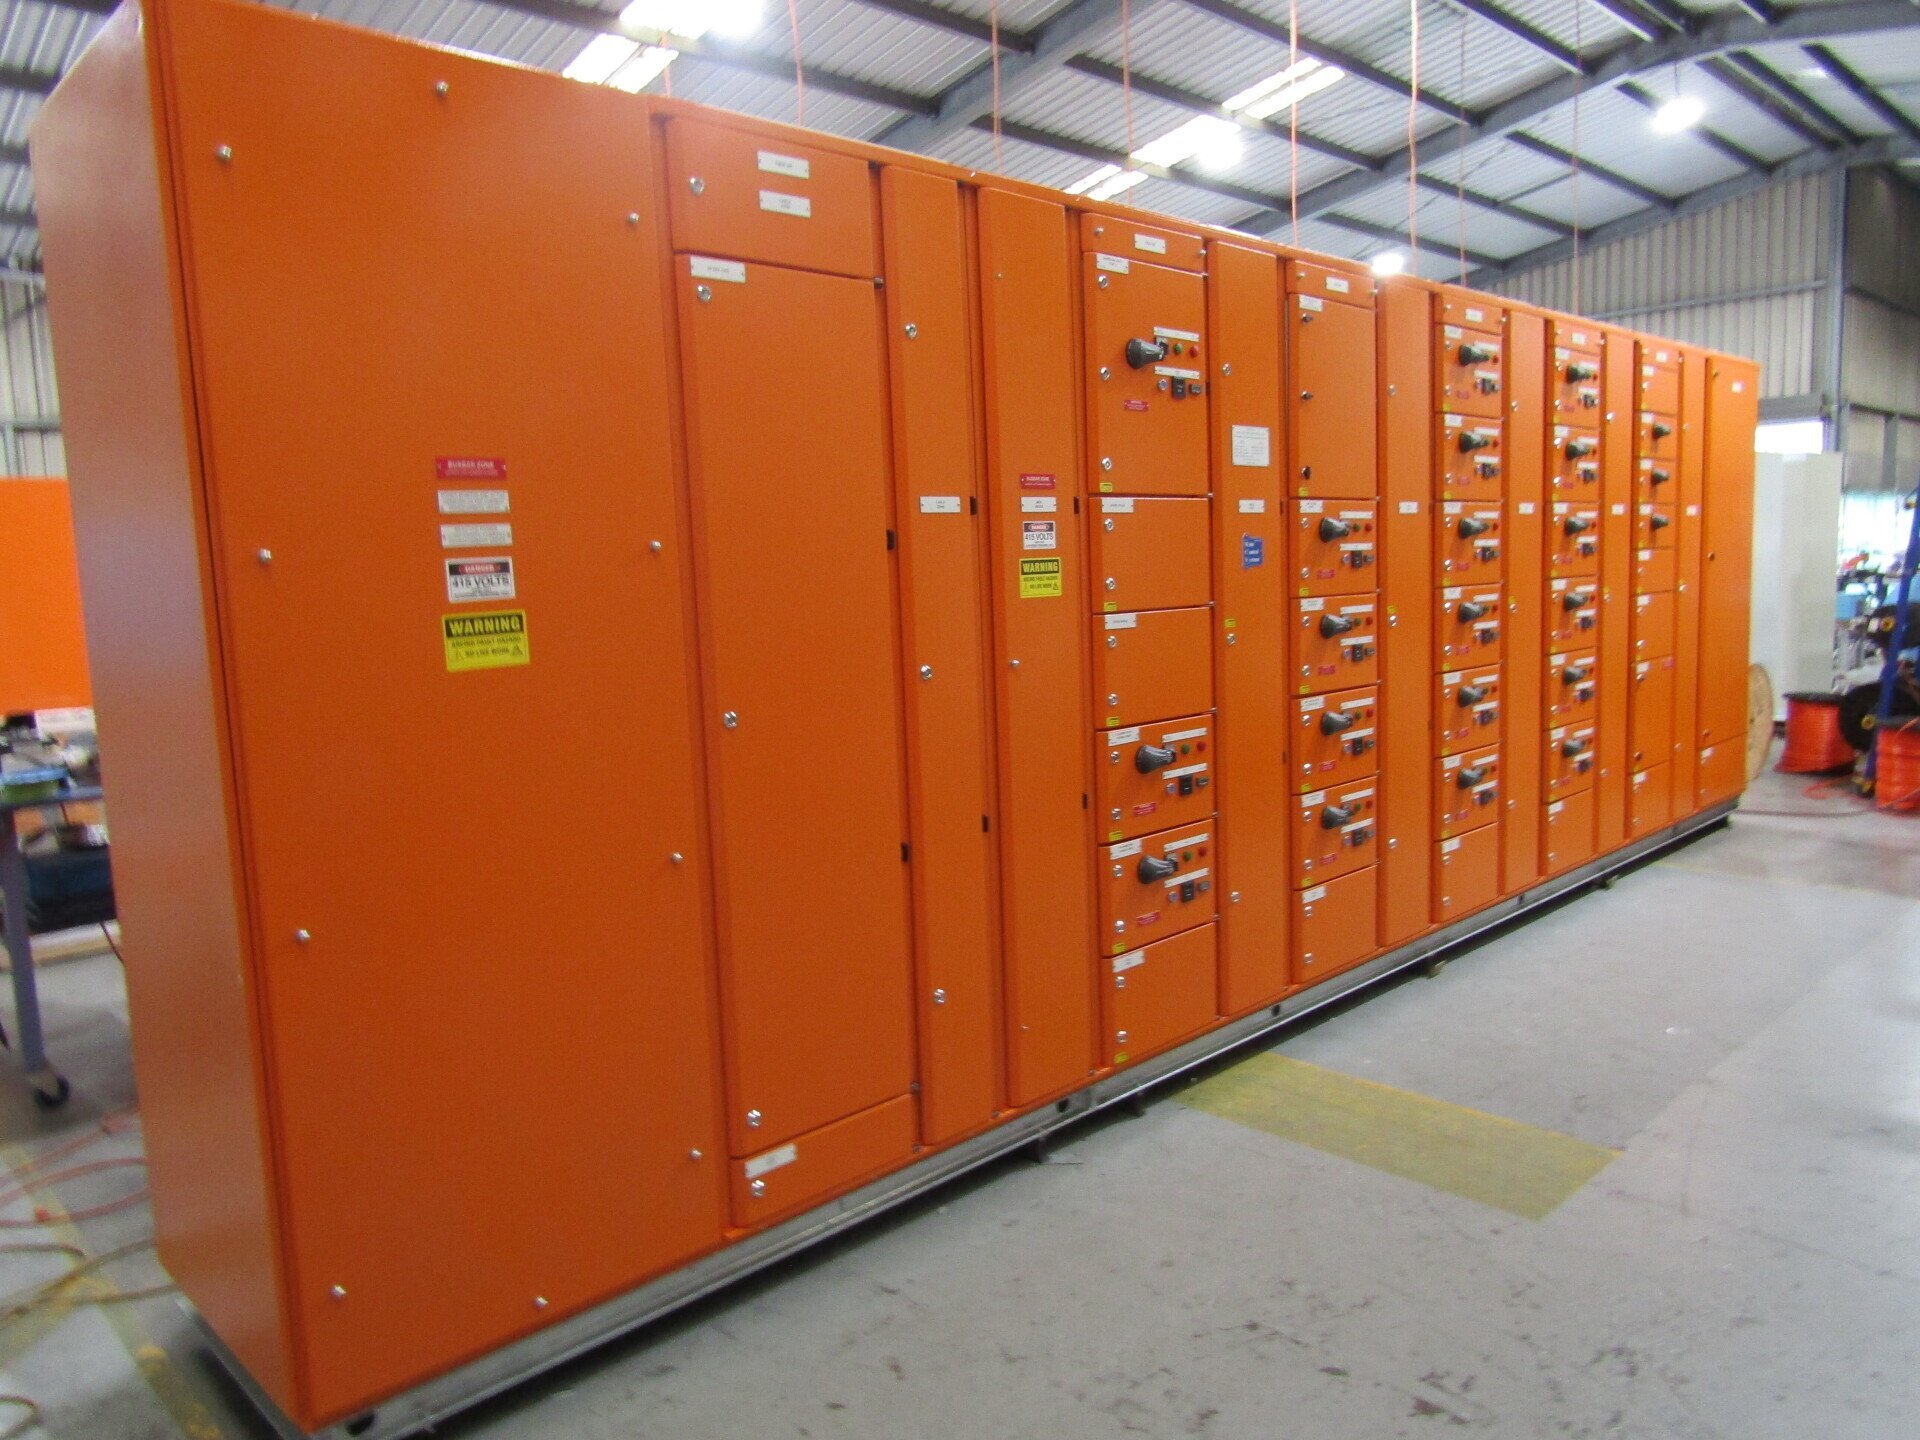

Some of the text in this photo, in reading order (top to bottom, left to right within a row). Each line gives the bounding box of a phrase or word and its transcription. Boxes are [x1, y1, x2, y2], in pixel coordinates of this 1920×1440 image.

[1025, 532, 1054, 541] 415 VOLTS
[464, 563, 495, 573] DANGER
[1022, 562, 1059, 574] WARNING
[452, 574, 510, 589] 415 VOLTS
[448, 615, 521, 637] WARNING
